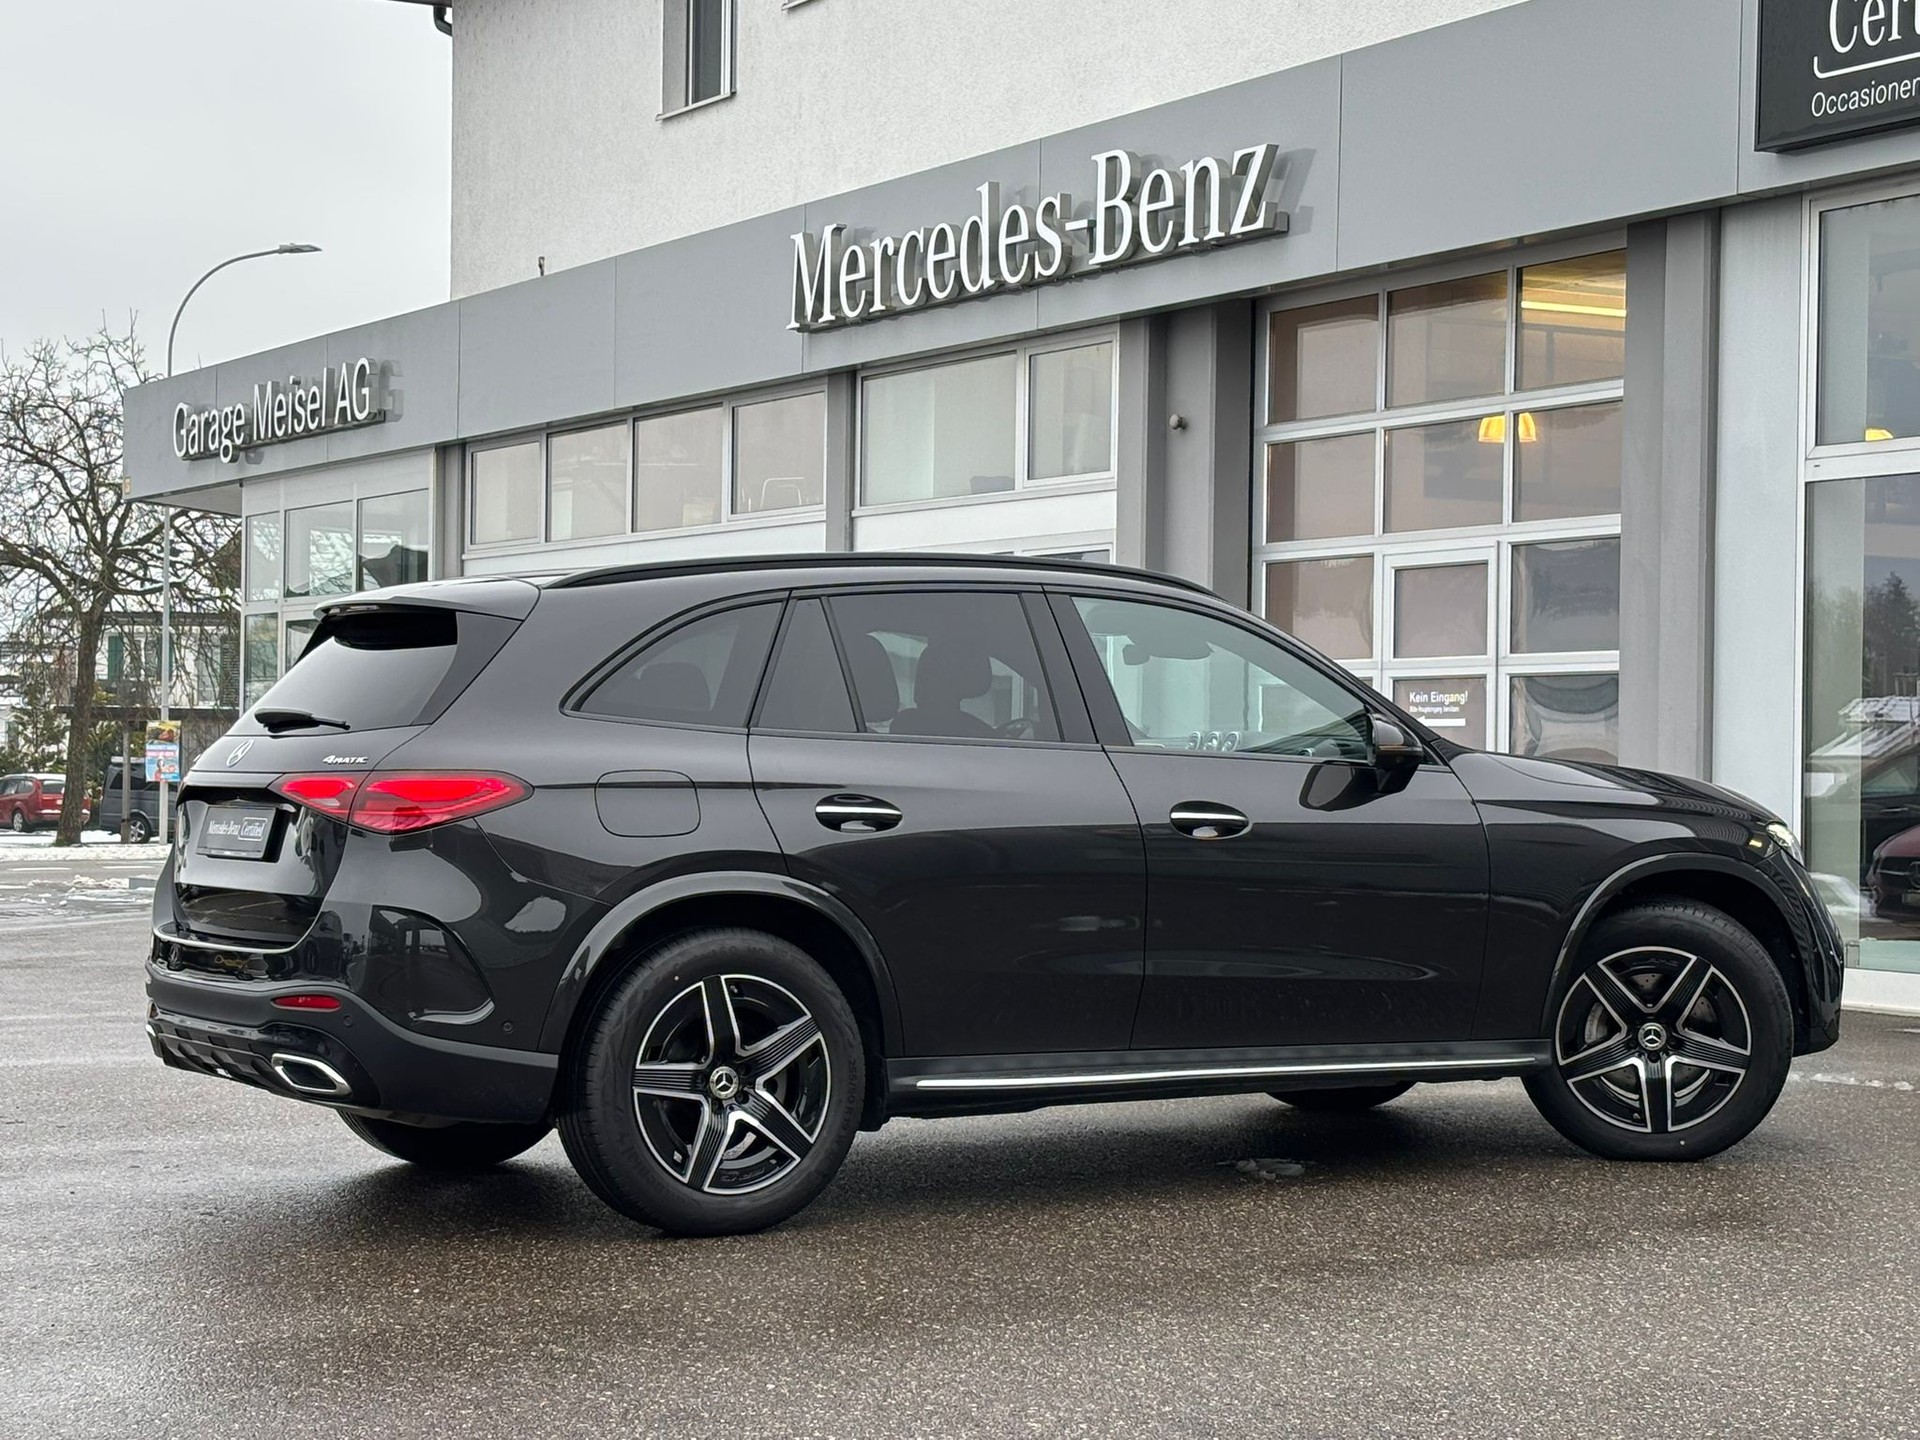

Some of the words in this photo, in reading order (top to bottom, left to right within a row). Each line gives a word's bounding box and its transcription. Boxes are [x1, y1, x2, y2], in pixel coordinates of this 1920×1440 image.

[787, 143, 1274, 331] Mercedes-Benz
[173, 402, 246, 464] Garage
[253, 366, 328, 441] Meisel
[334, 356, 371, 422] AG
[1409, 691, 1428, 703] Kein
[1430, 690, 1468, 706] Eingang!
[322, 755, 369, 764] 4MATIC
